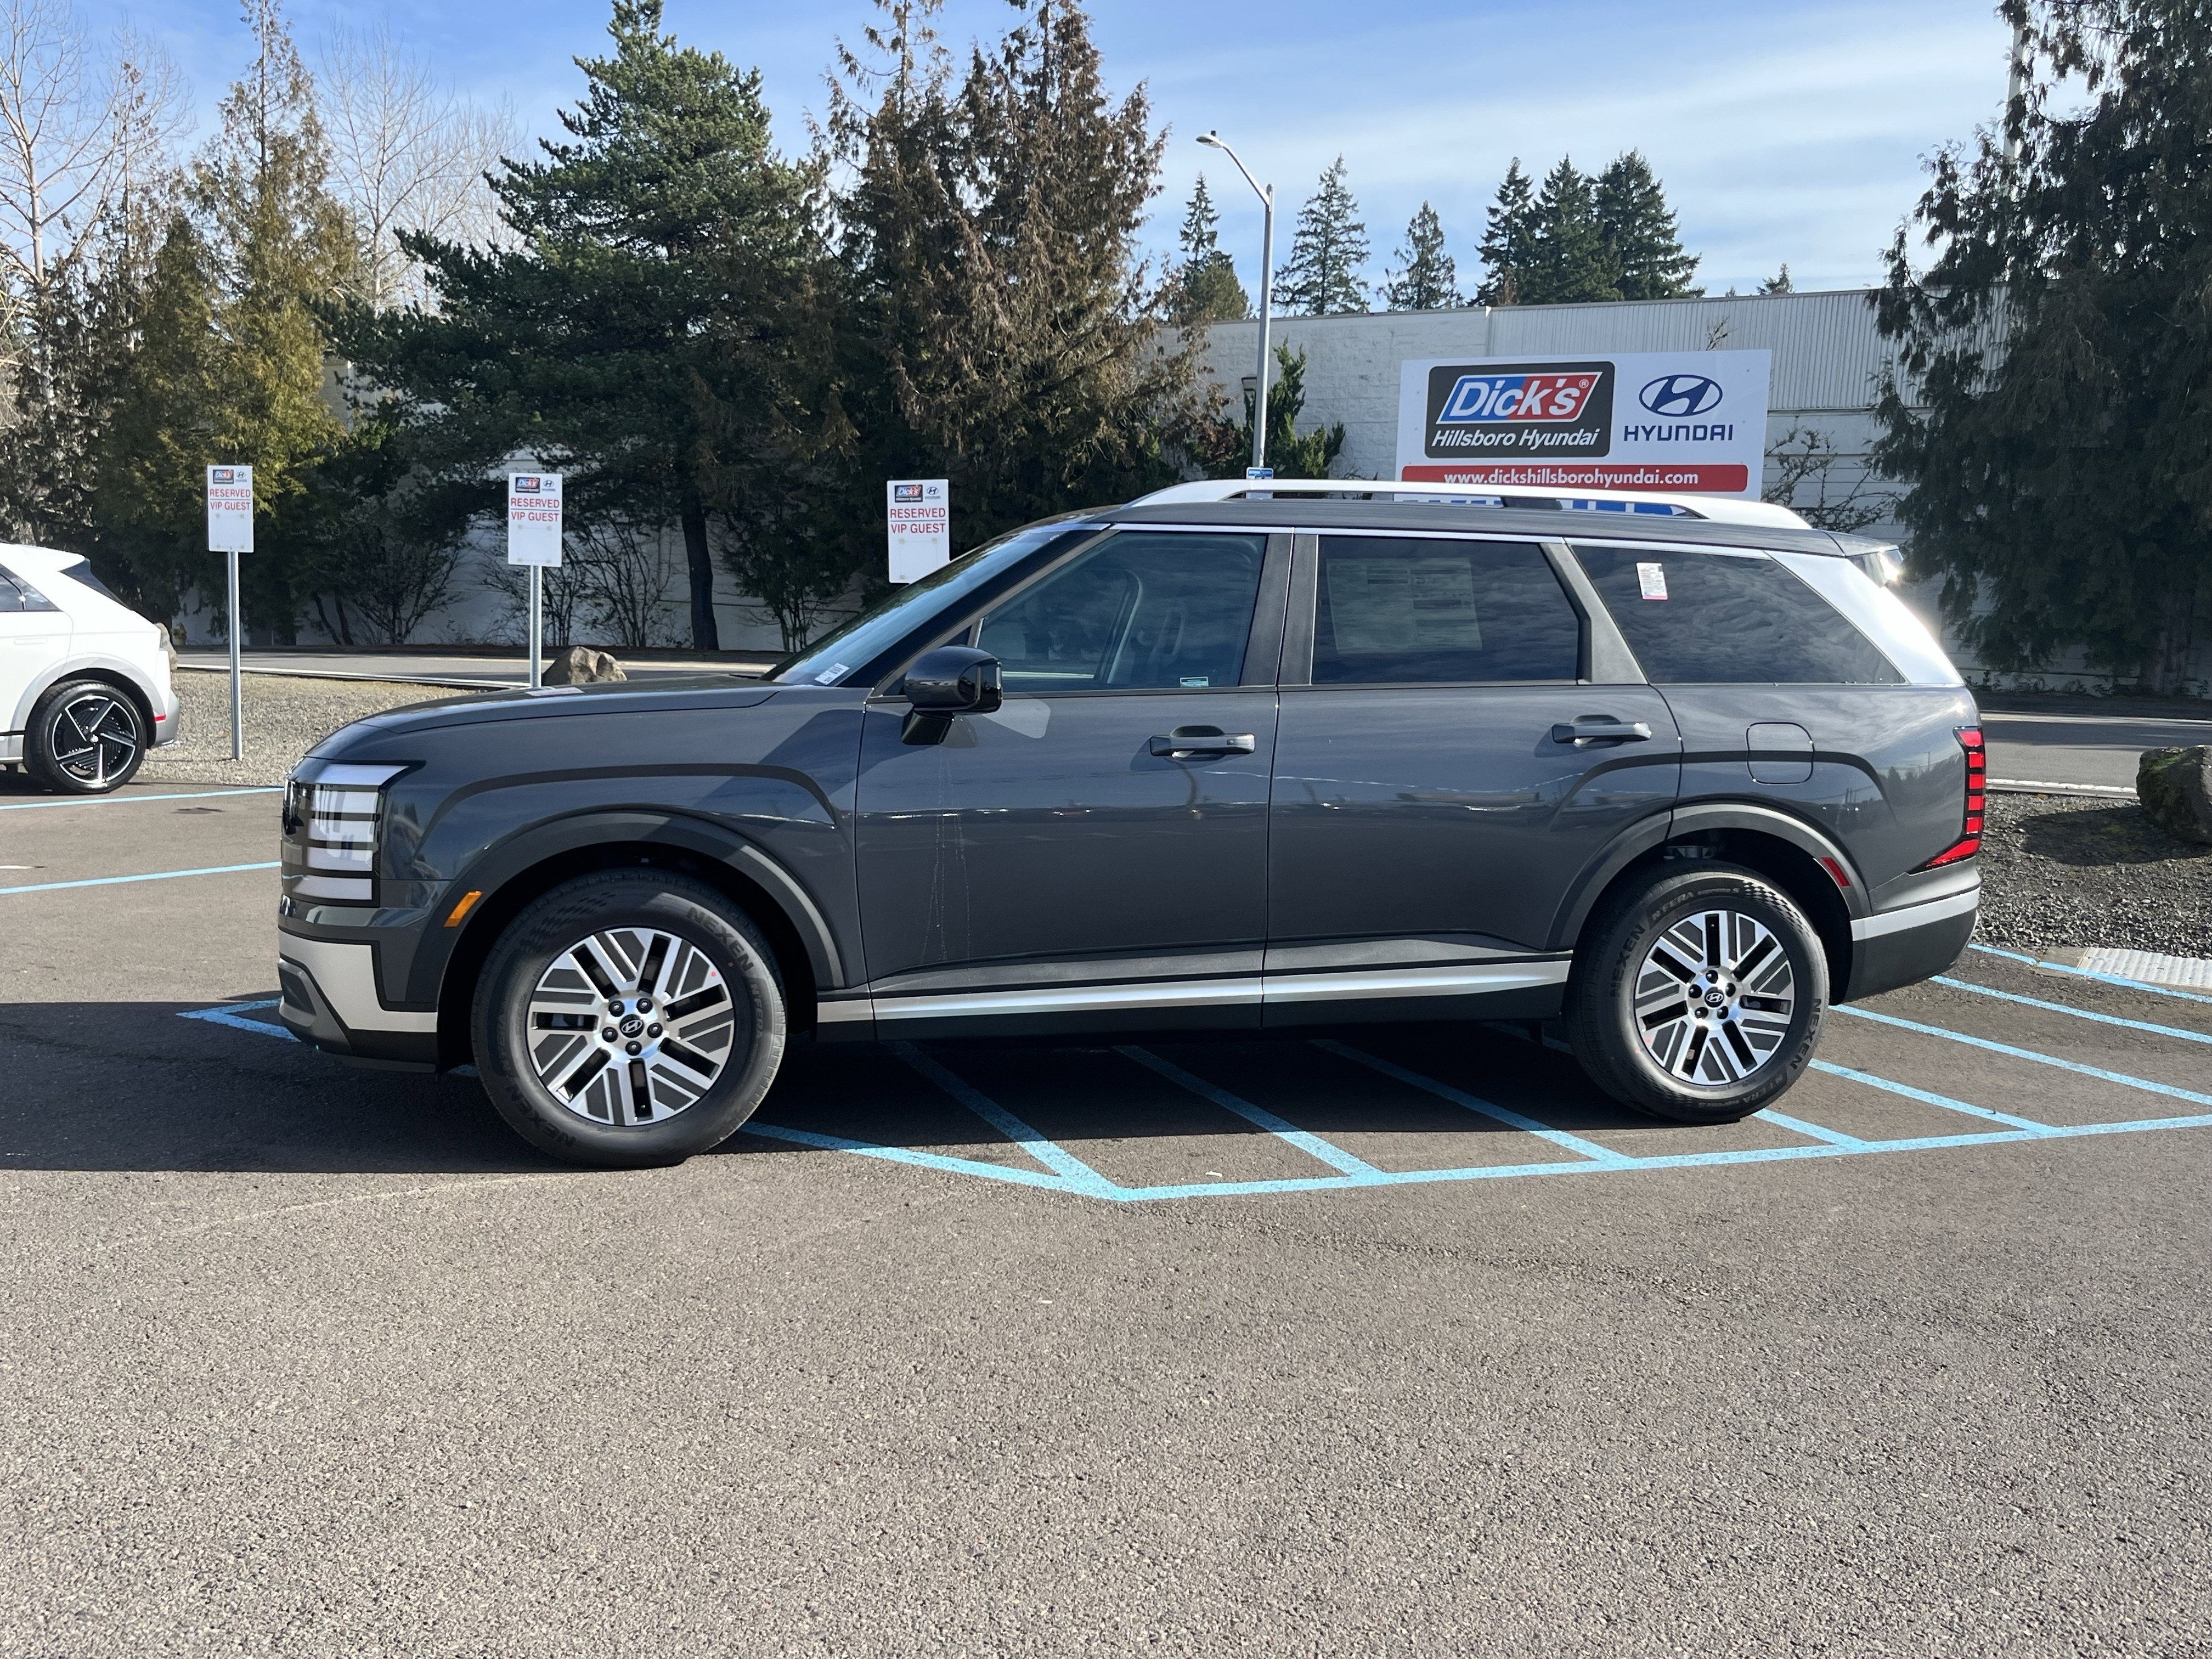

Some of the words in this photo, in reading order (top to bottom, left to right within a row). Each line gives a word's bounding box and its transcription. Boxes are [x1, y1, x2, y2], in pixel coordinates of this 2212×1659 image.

[1431, 430, 1516, 447] Hillsboro
[1518, 428, 1600, 450] Hyundai
[1623, 424, 1734, 442] HYUNDAI
[1444, 468, 1699, 488] www.dickshillsborohyundai.com
[210, 489, 251, 498] RESERVED
[210, 501, 222, 510] VIP
[224, 501, 251, 510] GUEST
[511, 498, 560, 508] RESERVED
[511, 511, 525, 520] VIP
[528, 512, 560, 522] GUEST
[890, 507, 946, 518] RESERVED
[890, 524, 907, 534] VIP
[910, 523, 946, 533] GUEST
[686, 906, 754, 972] NEXEN
[1610, 923, 1646, 997] NEXEN
[1789, 998, 1822, 1070] NEXEN
